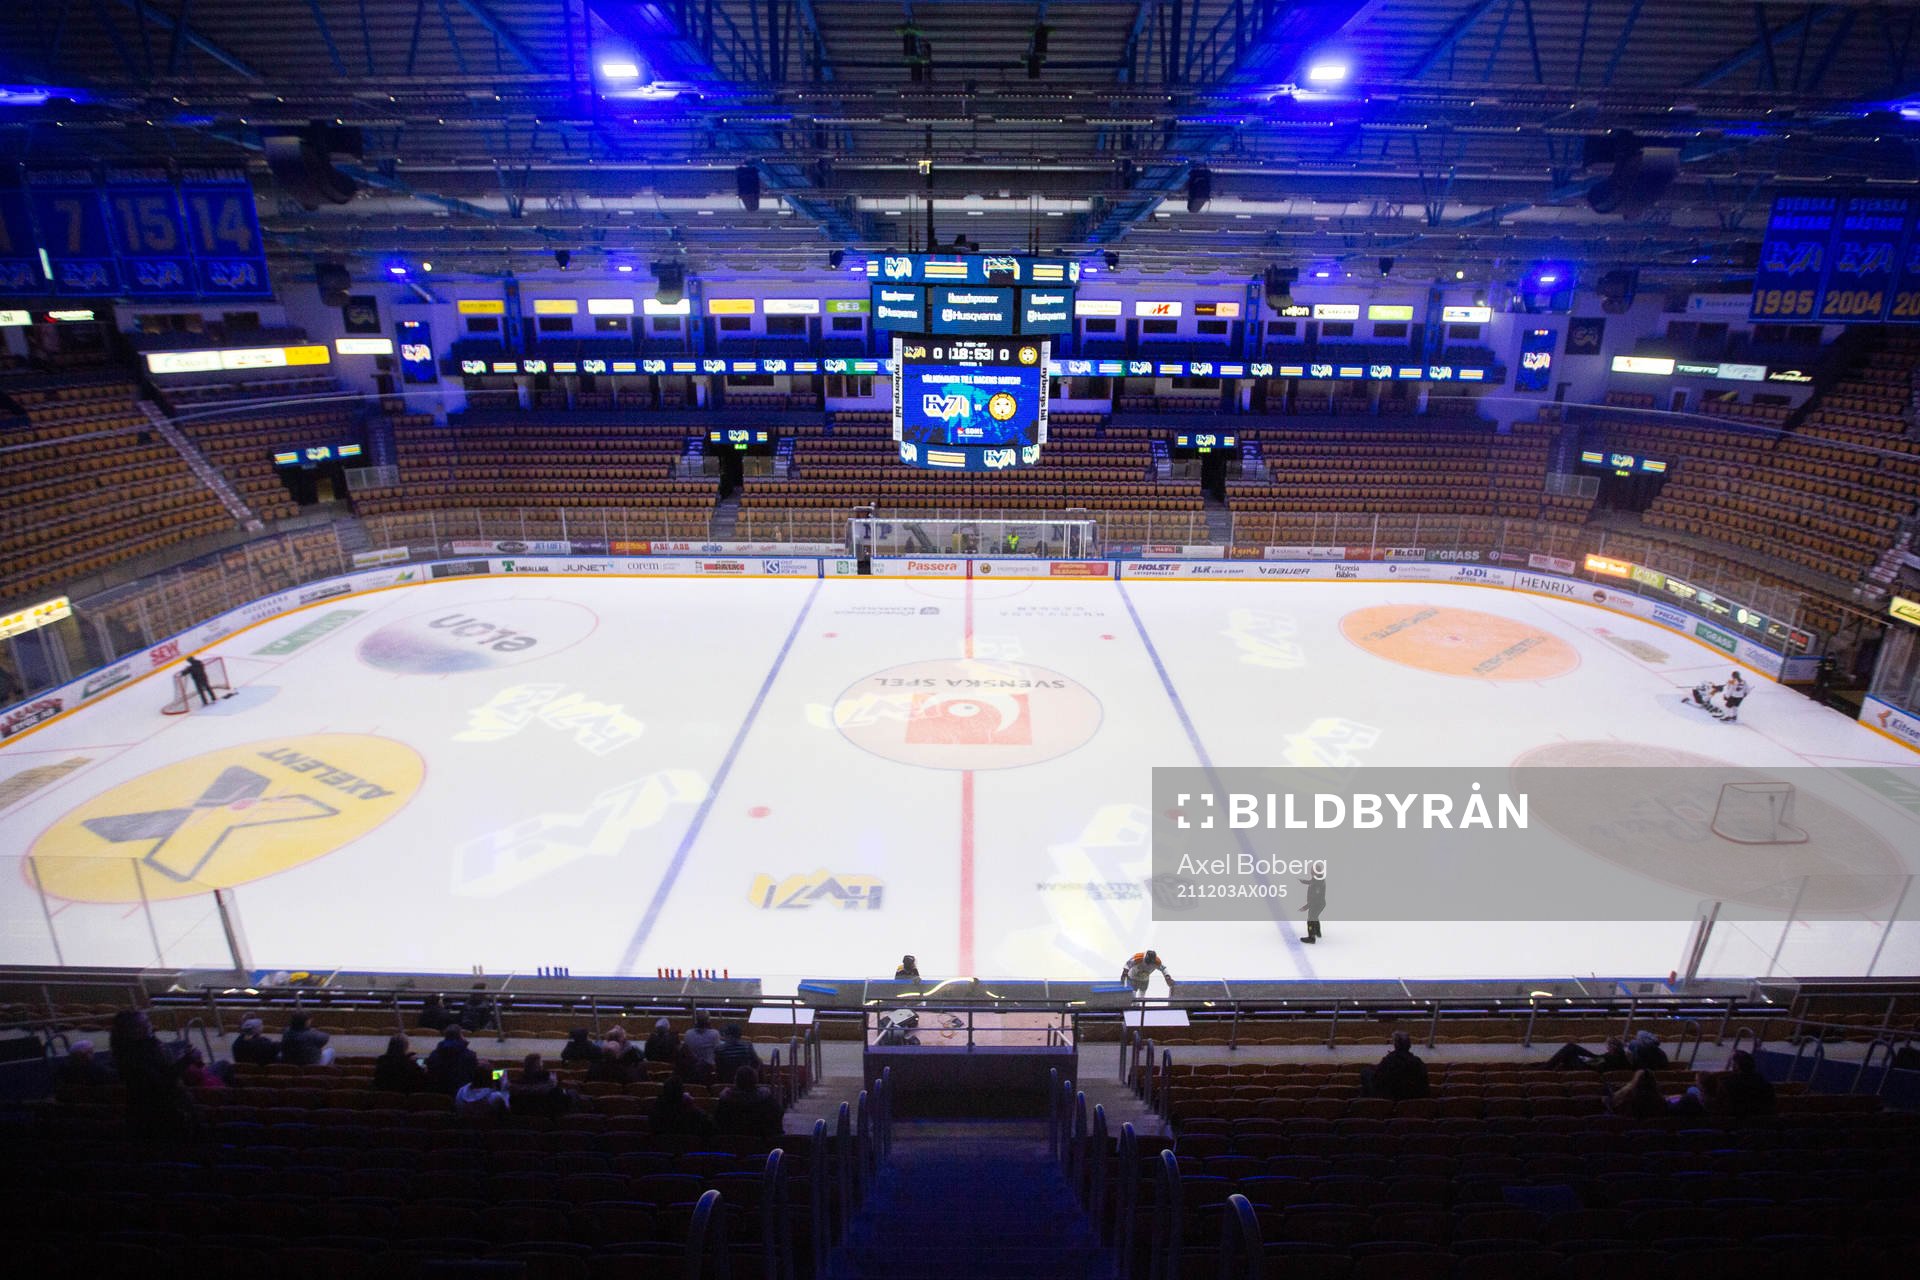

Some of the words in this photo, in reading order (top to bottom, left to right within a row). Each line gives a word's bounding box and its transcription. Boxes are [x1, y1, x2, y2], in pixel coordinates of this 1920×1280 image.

[54, 199, 82, 253] 7
[116, 197, 176, 251] 15
[192, 197, 252, 251] 14
[836, 302, 860, 311] SEB
[1754, 289, 1815, 314] 1995
[1823, 290, 1883, 315] 2004
[952, 310, 1003, 322] Husqvarna
[933, 347, 943, 360] 0
[999, 348, 1010, 361] 0
[923, 394, 970, 421] HV71
[1440, 550, 1480, 560] GRASS
[562, 564, 608, 572] JUNET
[627, 562, 660, 571] corem
[907, 561, 958, 571] Passera
[1268, 567, 1311, 575] BAUER
[1457, 567, 1488, 578] JoDi
[1520, 576, 1576, 595] HENRIX
[149, 640, 180, 660] SEW
[874, 678, 937, 688] SPEL
[944, 678, 1066, 689] SVENSKA
[752, 873, 884, 911] HV71
